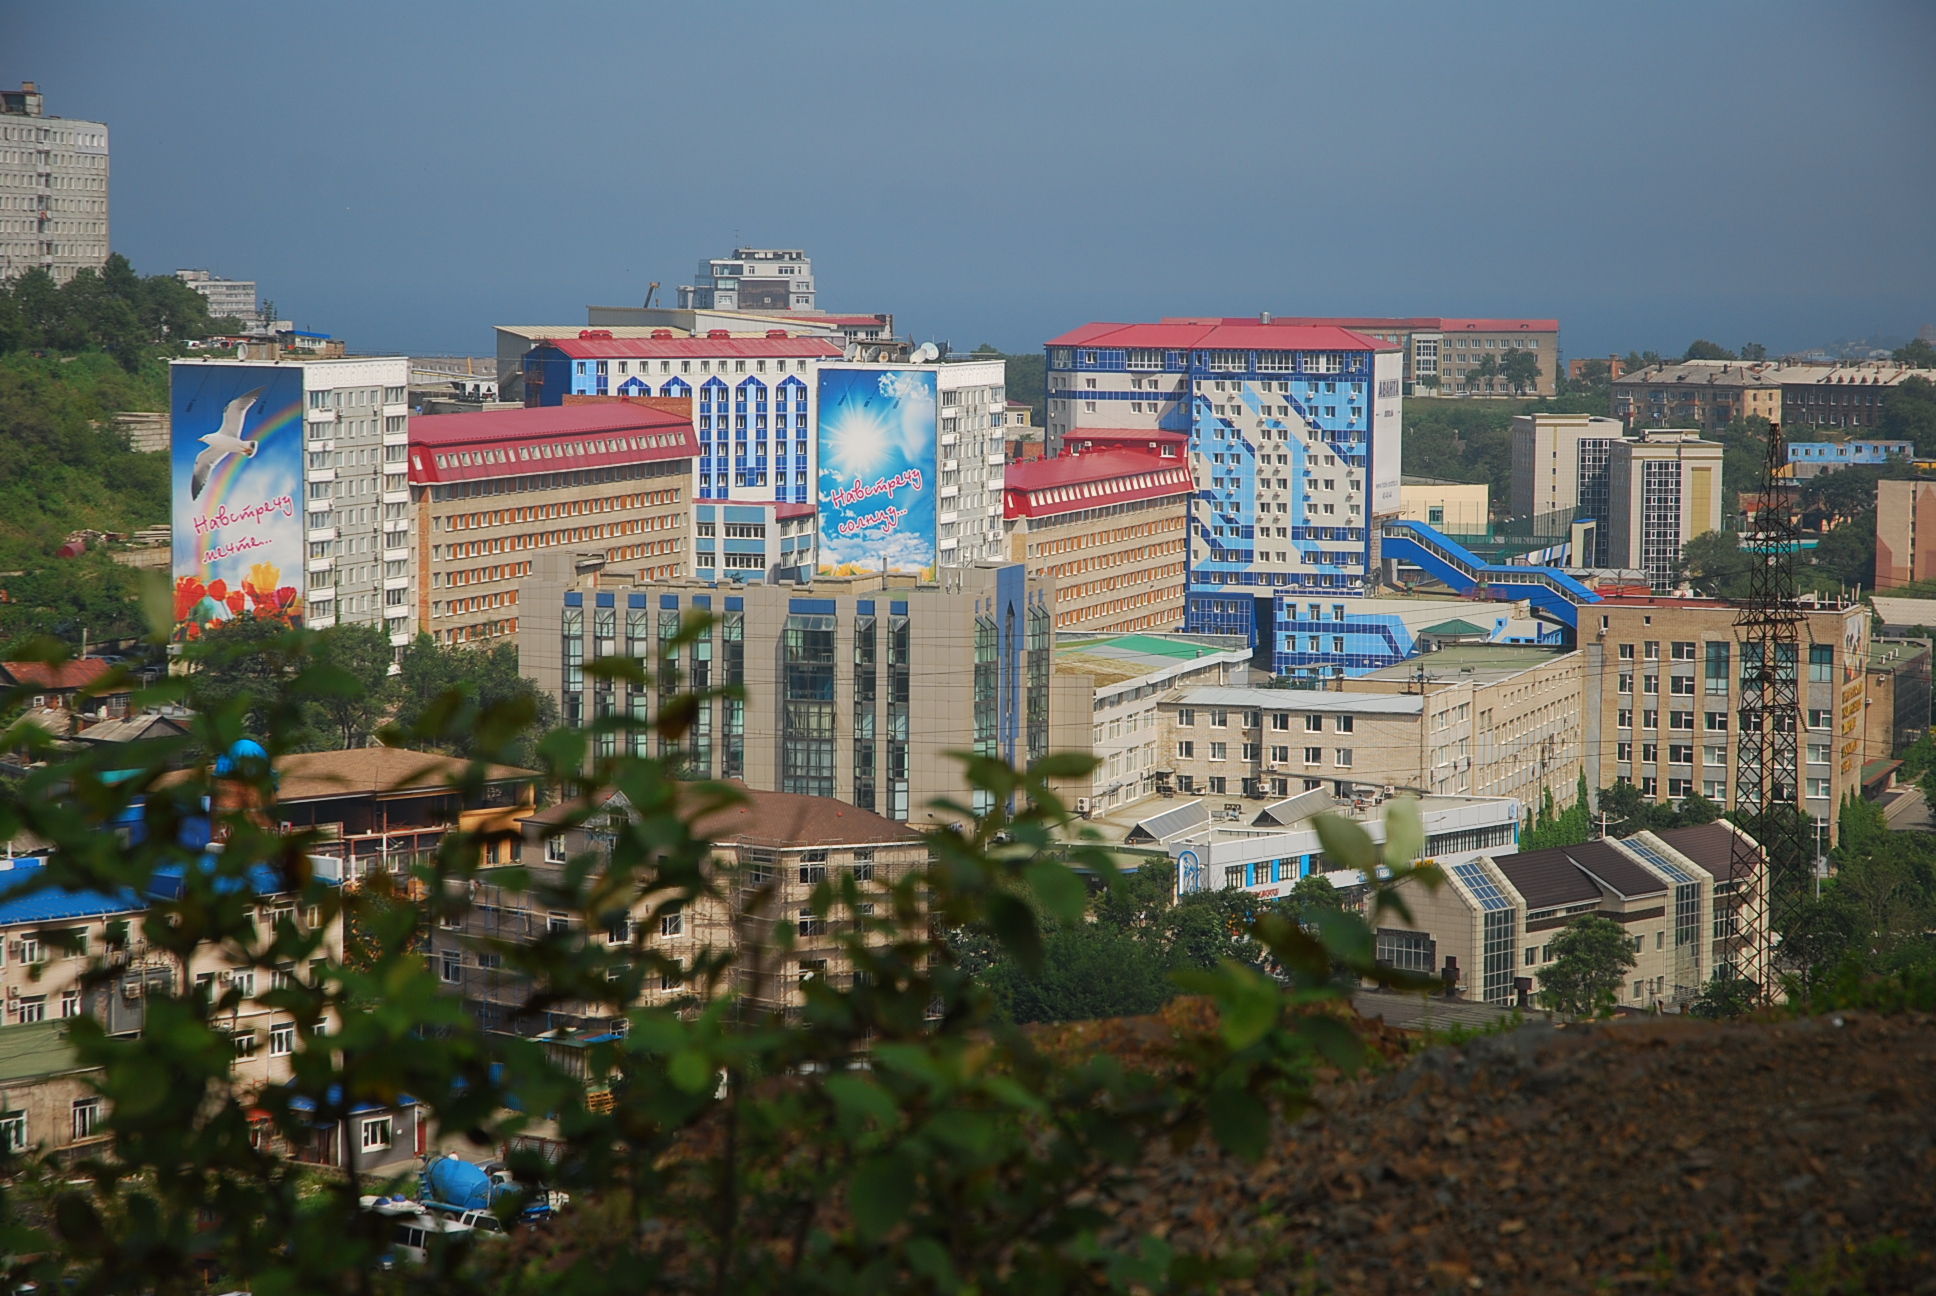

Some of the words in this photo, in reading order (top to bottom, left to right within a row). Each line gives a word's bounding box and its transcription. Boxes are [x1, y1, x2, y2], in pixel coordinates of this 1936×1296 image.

[831, 469, 922, 507] Навстречу
[194, 496, 293, 534] Навстречу
[839, 506, 907, 533] солнцу...
[204, 536, 273, 563] мечте...
